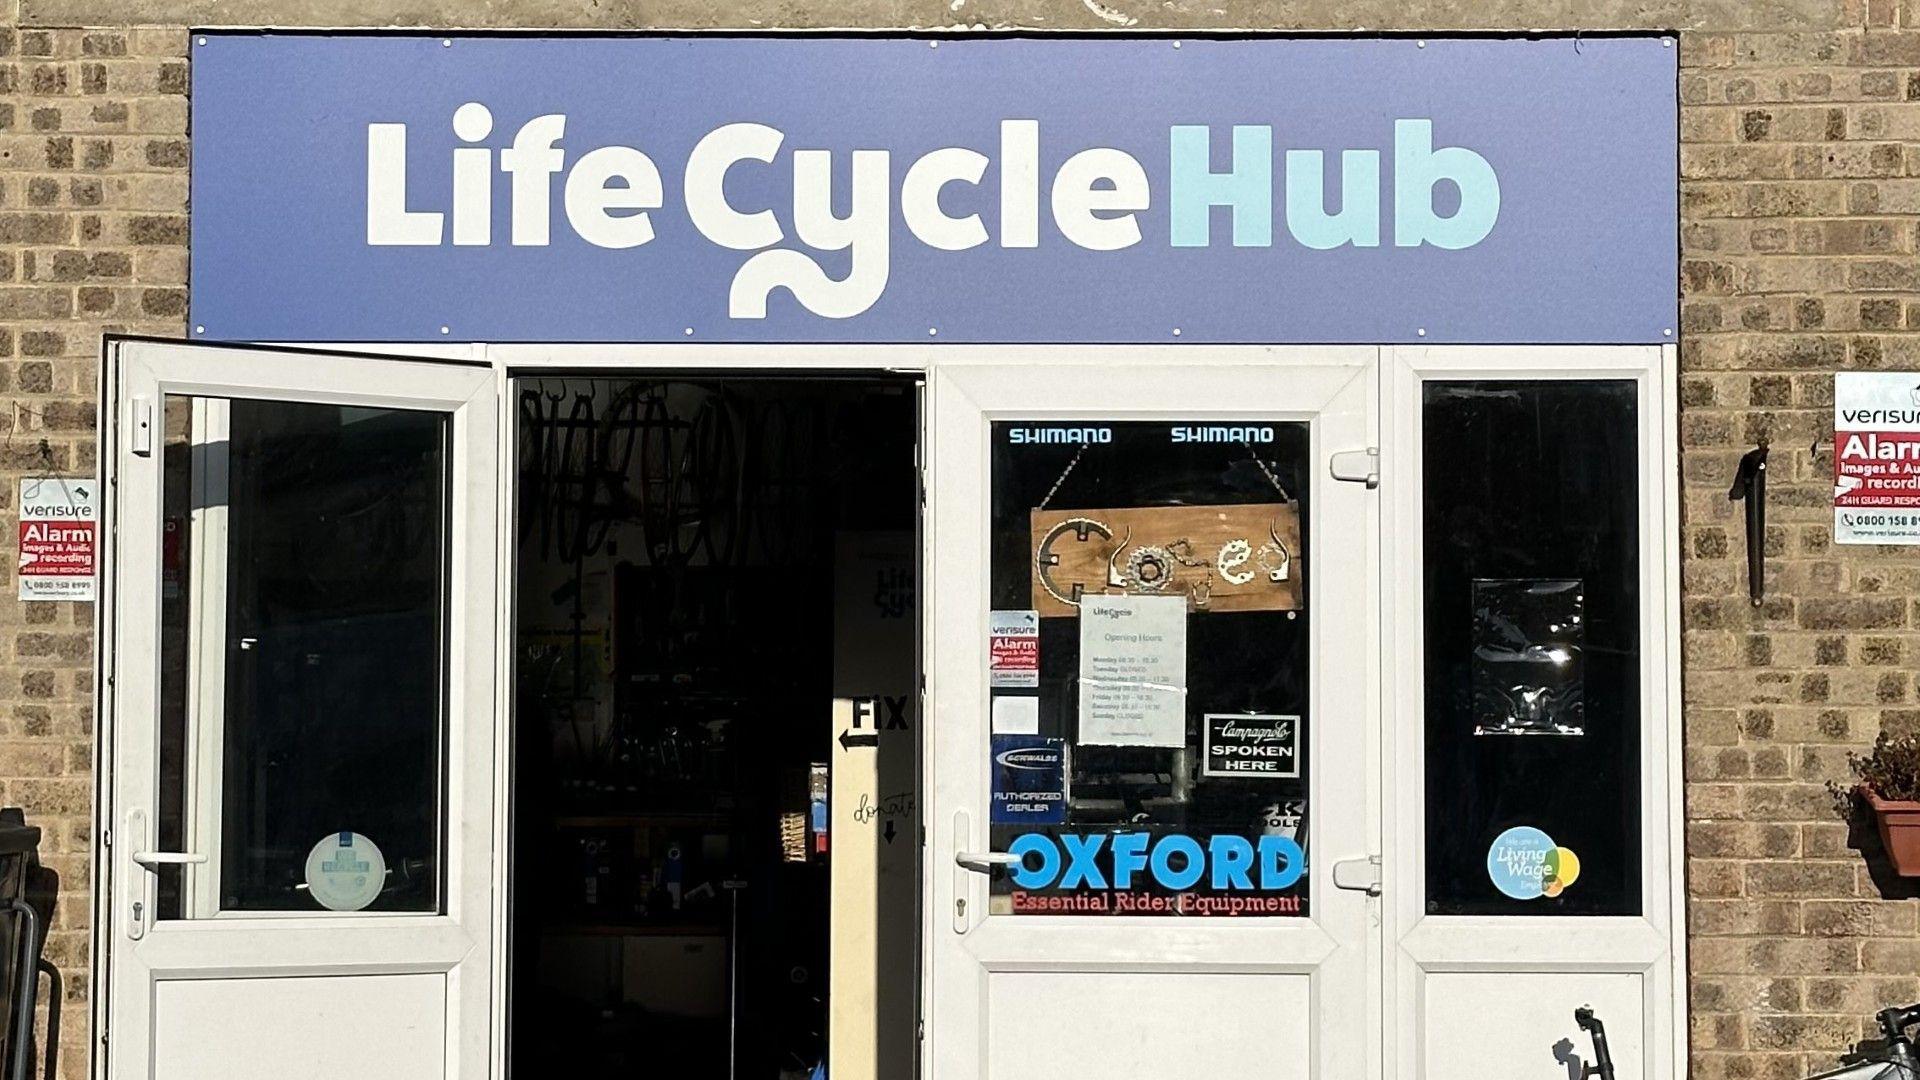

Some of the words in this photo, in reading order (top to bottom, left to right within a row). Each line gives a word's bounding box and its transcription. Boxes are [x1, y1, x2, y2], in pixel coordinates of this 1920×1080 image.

[1170, 118, 1500, 249] Hub
[1009, 428, 1112, 443] SHIMANO
[1171, 427, 1274, 442] SHIMANO
[1841, 462, 1886, 476] Images
[1889, 462, 1900, 474] &
[24, 505, 92, 516] verisure
[1856, 516, 1885, 525] 0800
[1888, 515, 1908, 525] 158
[22, 523, 92, 542] Alarm
[40, 553, 92, 565] recording
[993, 638, 1036, 650] Alarm
[1214, 720, 1291, 744] Campagnolo
[1211, 745, 1293, 757] SPOKEN
[1225, 761, 1278, 771] HERE
[994, 792, 1062, 800] AUTHORIZED
[1006, 804, 1049, 812] DEALER
[1007, 832, 1304, 890] OXFORD
[1497, 846, 1547, 864] Living
[1507, 861, 1553, 880] Wage
[1011, 890, 1109, 911] Essential
[1114, 893, 1173, 911] Rider
[1180, 892, 1301, 915] Equipment
